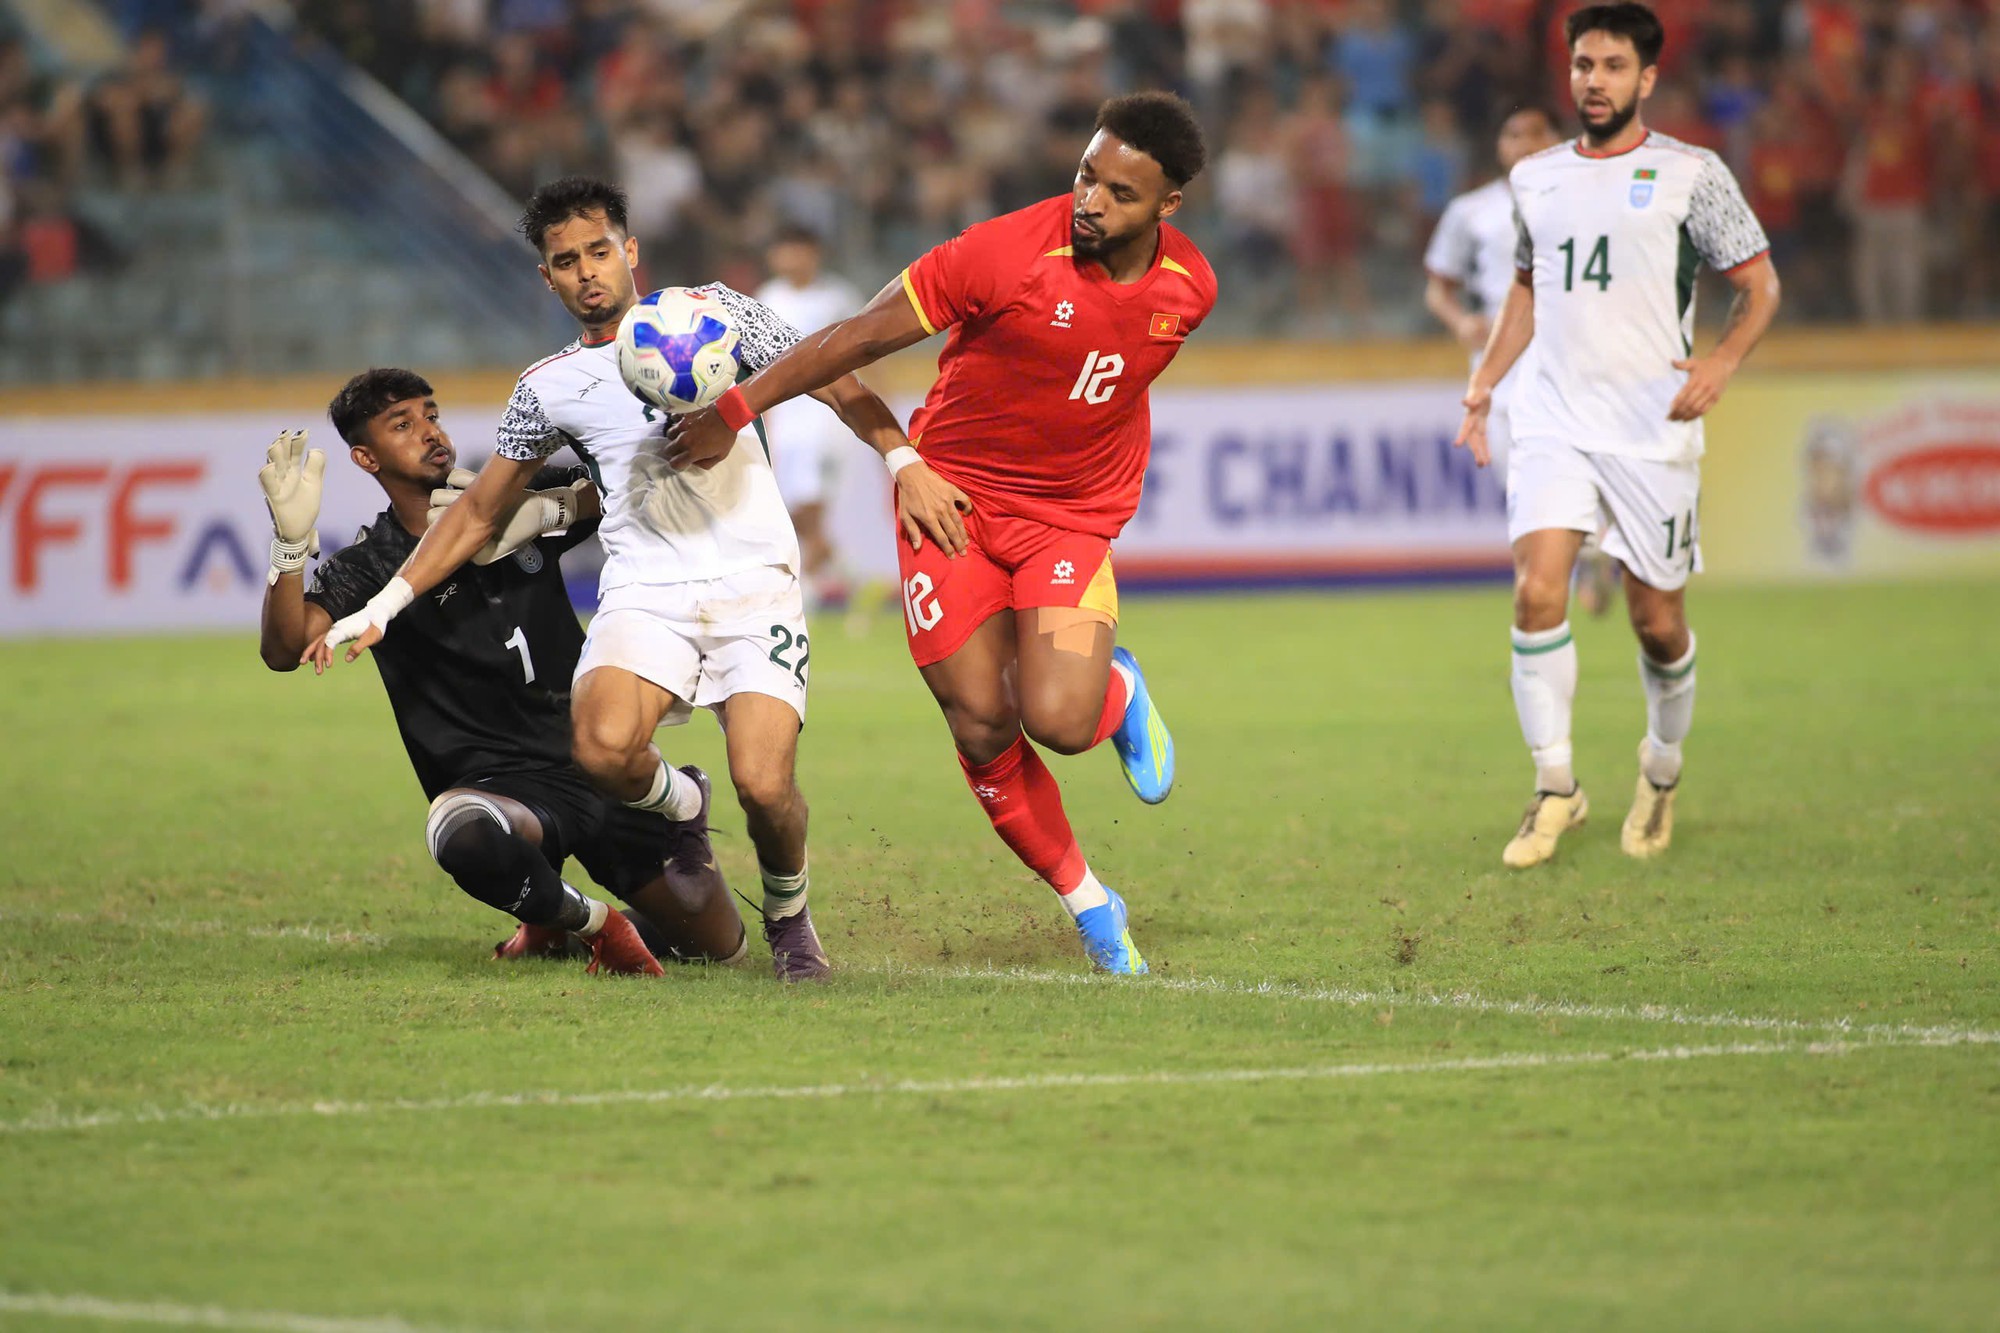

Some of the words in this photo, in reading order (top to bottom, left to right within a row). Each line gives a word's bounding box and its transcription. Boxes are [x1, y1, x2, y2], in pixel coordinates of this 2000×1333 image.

[1558, 235, 1612, 292] 14
[1069, 350, 1125, 405] 12
[1203, 432, 1508, 522] CHANN
[0, 462, 206, 590] FF
[1661, 509, 1695, 567] 14
[902, 571, 944, 636] 12
[504, 625, 536, 685] 1
[770, 624, 809, 687] 22
